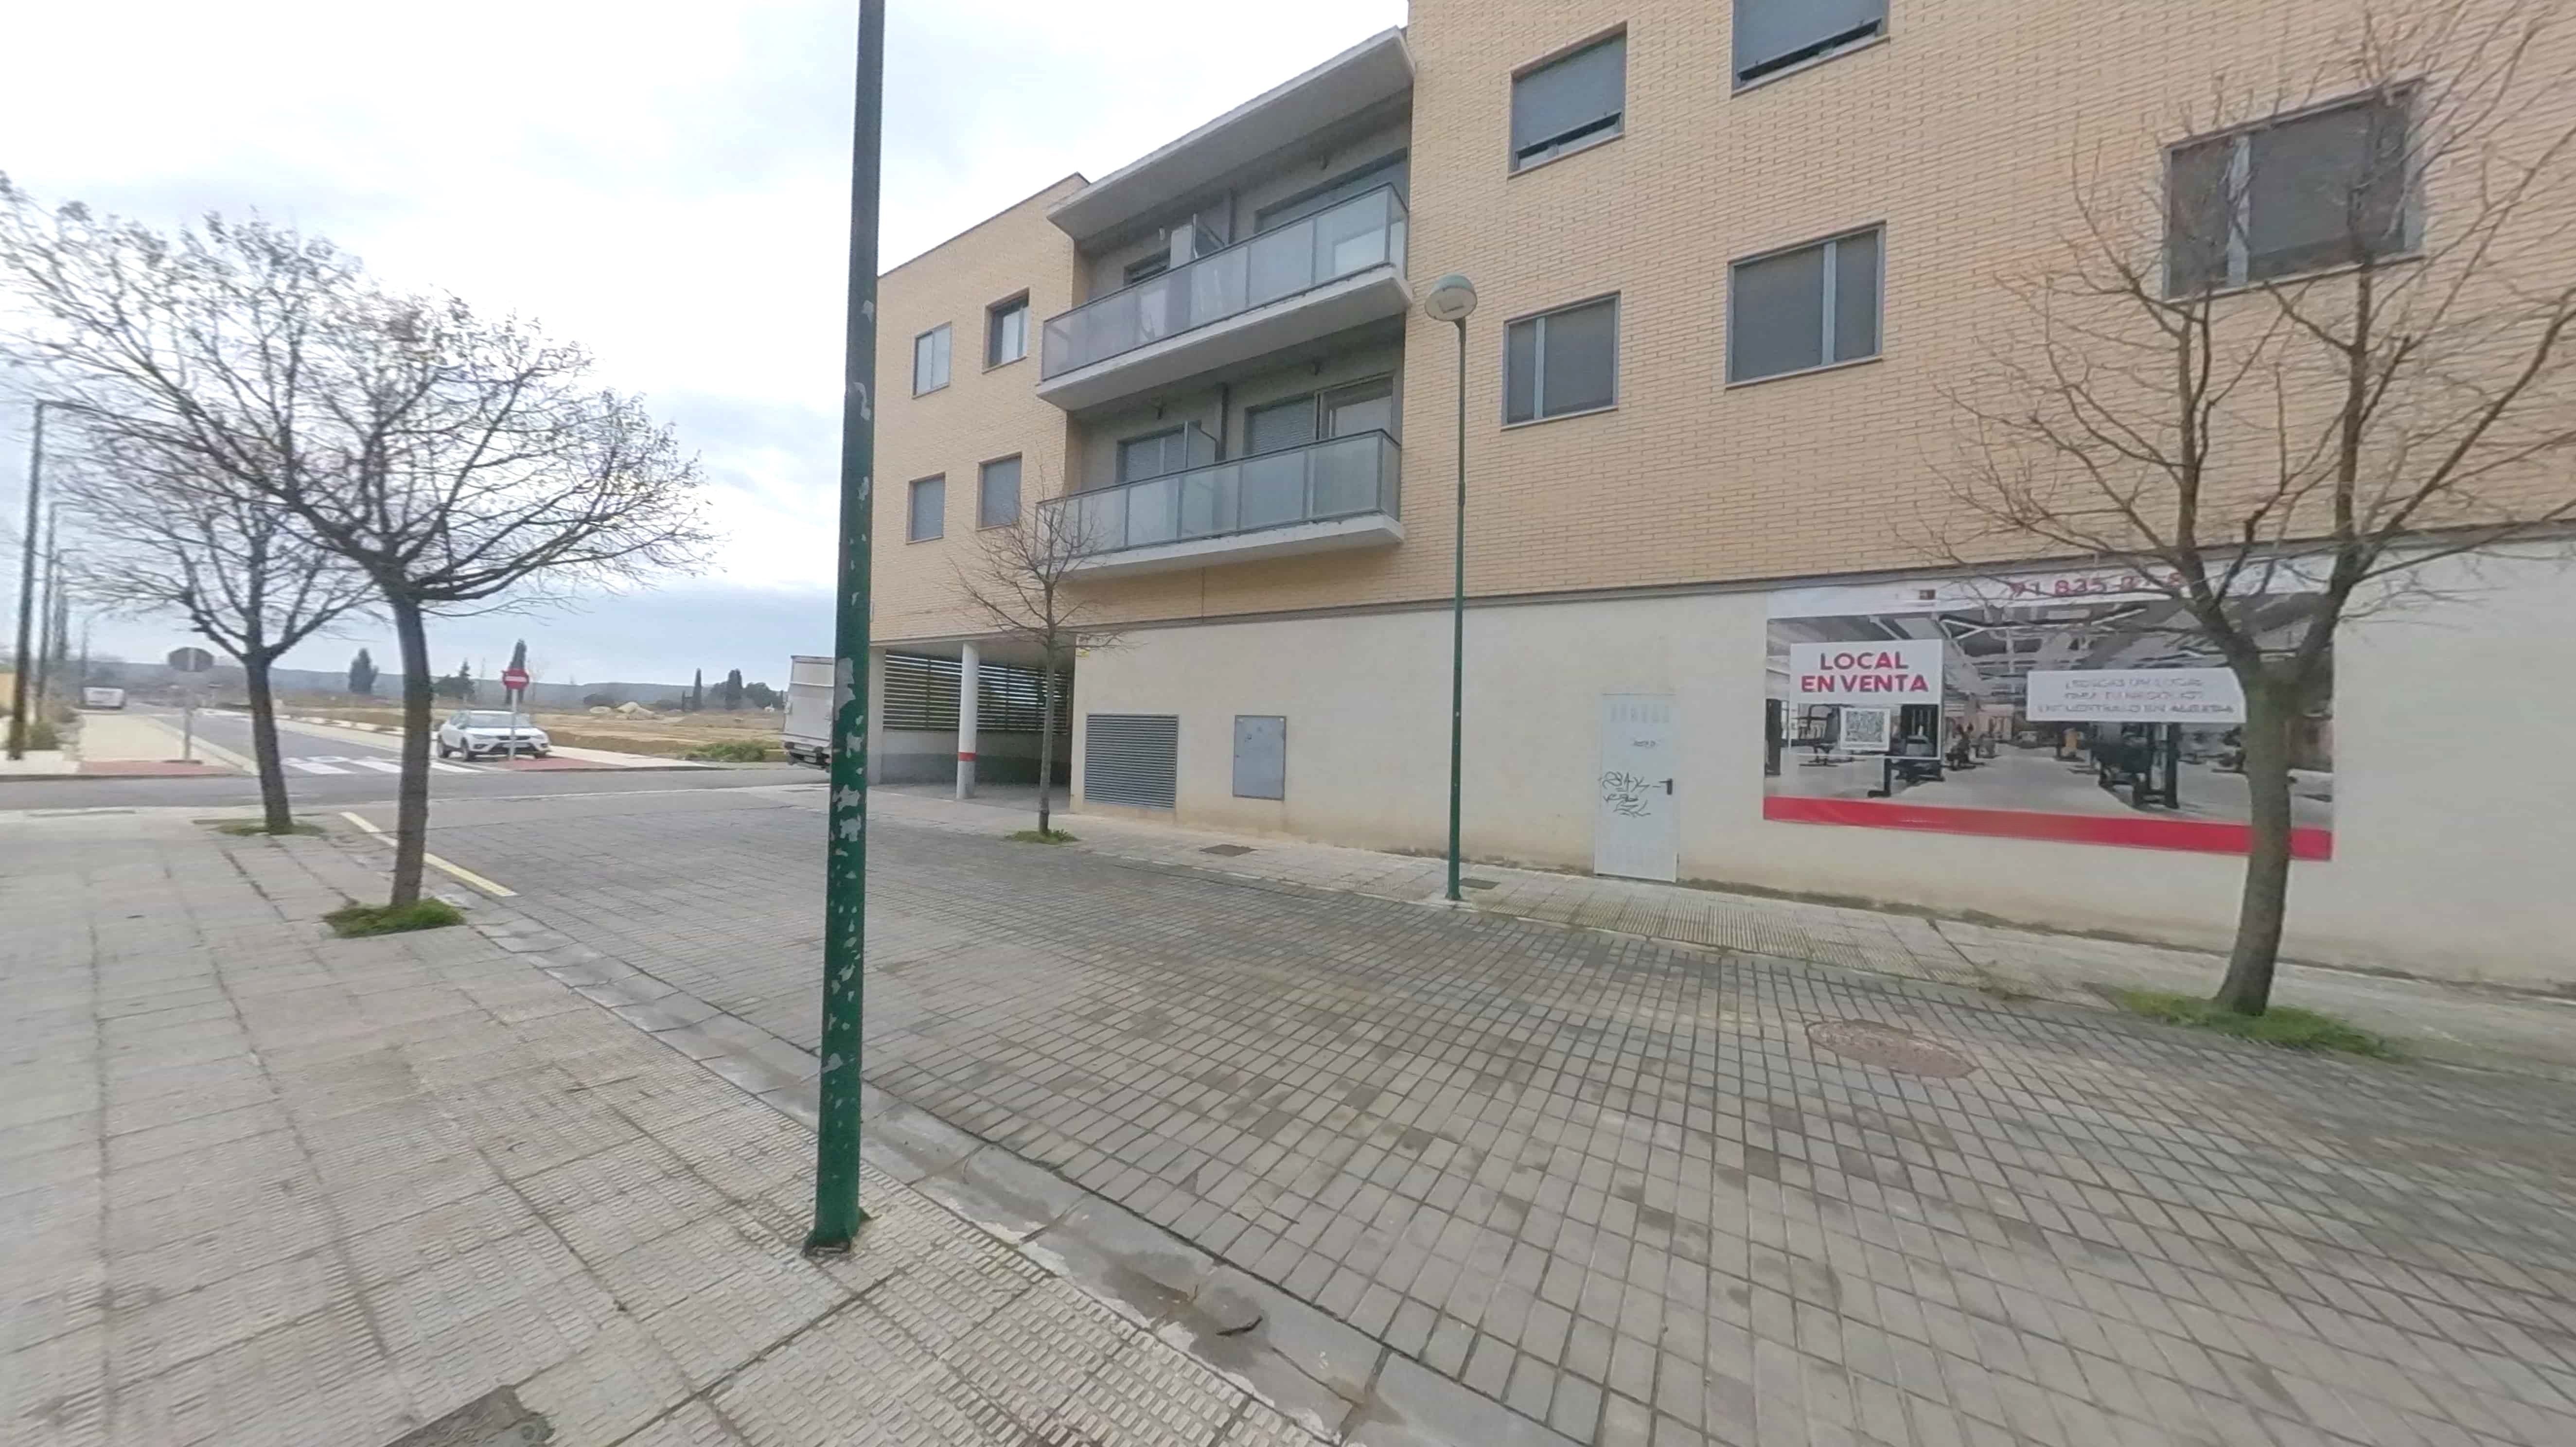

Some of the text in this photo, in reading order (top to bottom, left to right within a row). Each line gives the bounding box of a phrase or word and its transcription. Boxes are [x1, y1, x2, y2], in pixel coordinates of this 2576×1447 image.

[1820, 651, 1909, 670] LOCAL
[1801, 674, 1929, 692] EN VENTA
